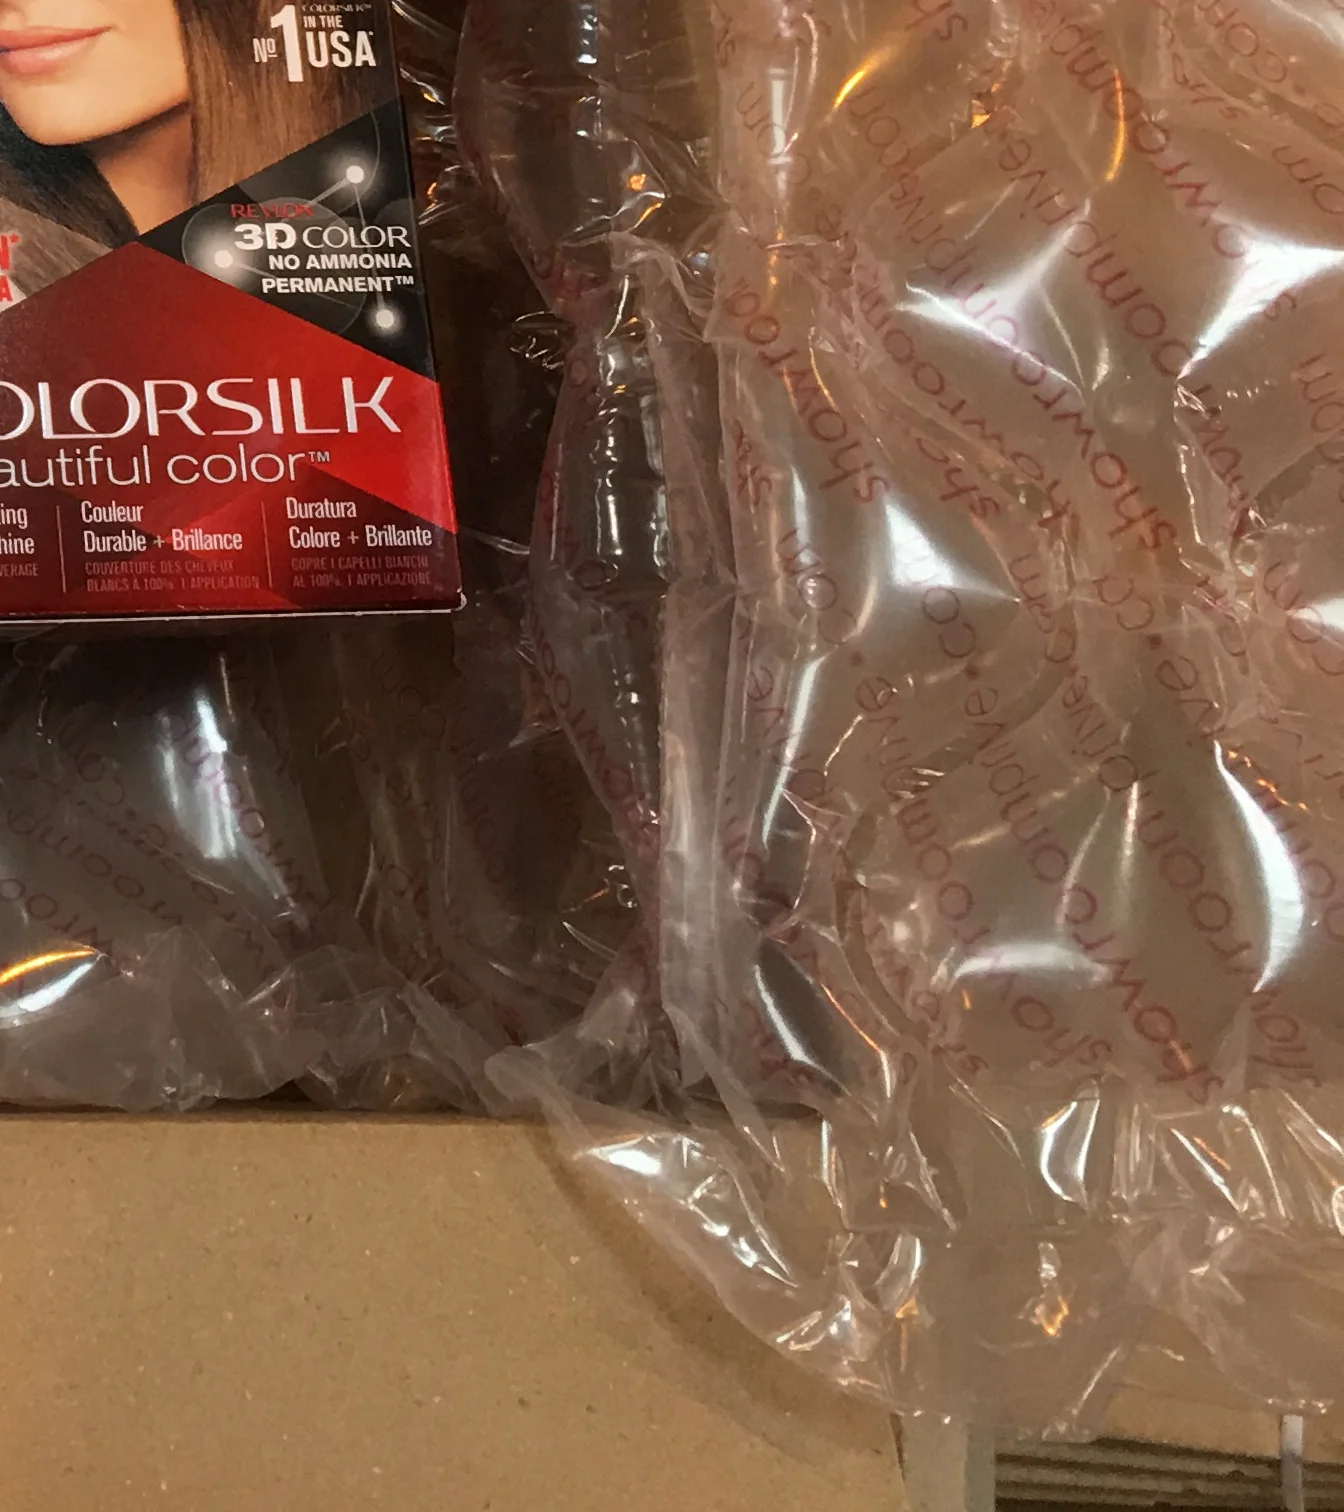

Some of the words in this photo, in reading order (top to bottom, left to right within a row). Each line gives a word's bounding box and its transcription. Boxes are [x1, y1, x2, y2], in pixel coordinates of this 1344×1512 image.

[303, 15, 317, 29] IN
[319, 14, 344, 29] THE
[270, 4, 304, 82] 1
[234, 222, 297, 250] 3D
[302, 225, 412, 248] COLOR
[268, 254, 300, 270] NO
[306, 253, 413, 269] AMMONIA
[81, 500, 144, 524] Couleur
[286, 497, 357, 519] Duratura
[83, 530, 147, 554] Durable
[171, 528, 243, 551] Brillance
[289, 526, 341, 549] Colore
[364, 524, 433, 547] Brillante
[85, 560, 156, 576] COUVERTURE
[160, 560, 181, 574] DES
[184, 559, 234, 574] CHEVEUX
[291, 557, 327, 570] COPRE
[338, 556, 382, 570] CAPELLI
[385, 555, 429, 569] BIANCHI
[86, 578, 129, 593] BLANCS
[190, 575, 260, 590] APPLICATION
[293, 575, 305, 588] AL
[356, 572, 432, 586] APPLICAZIONE
